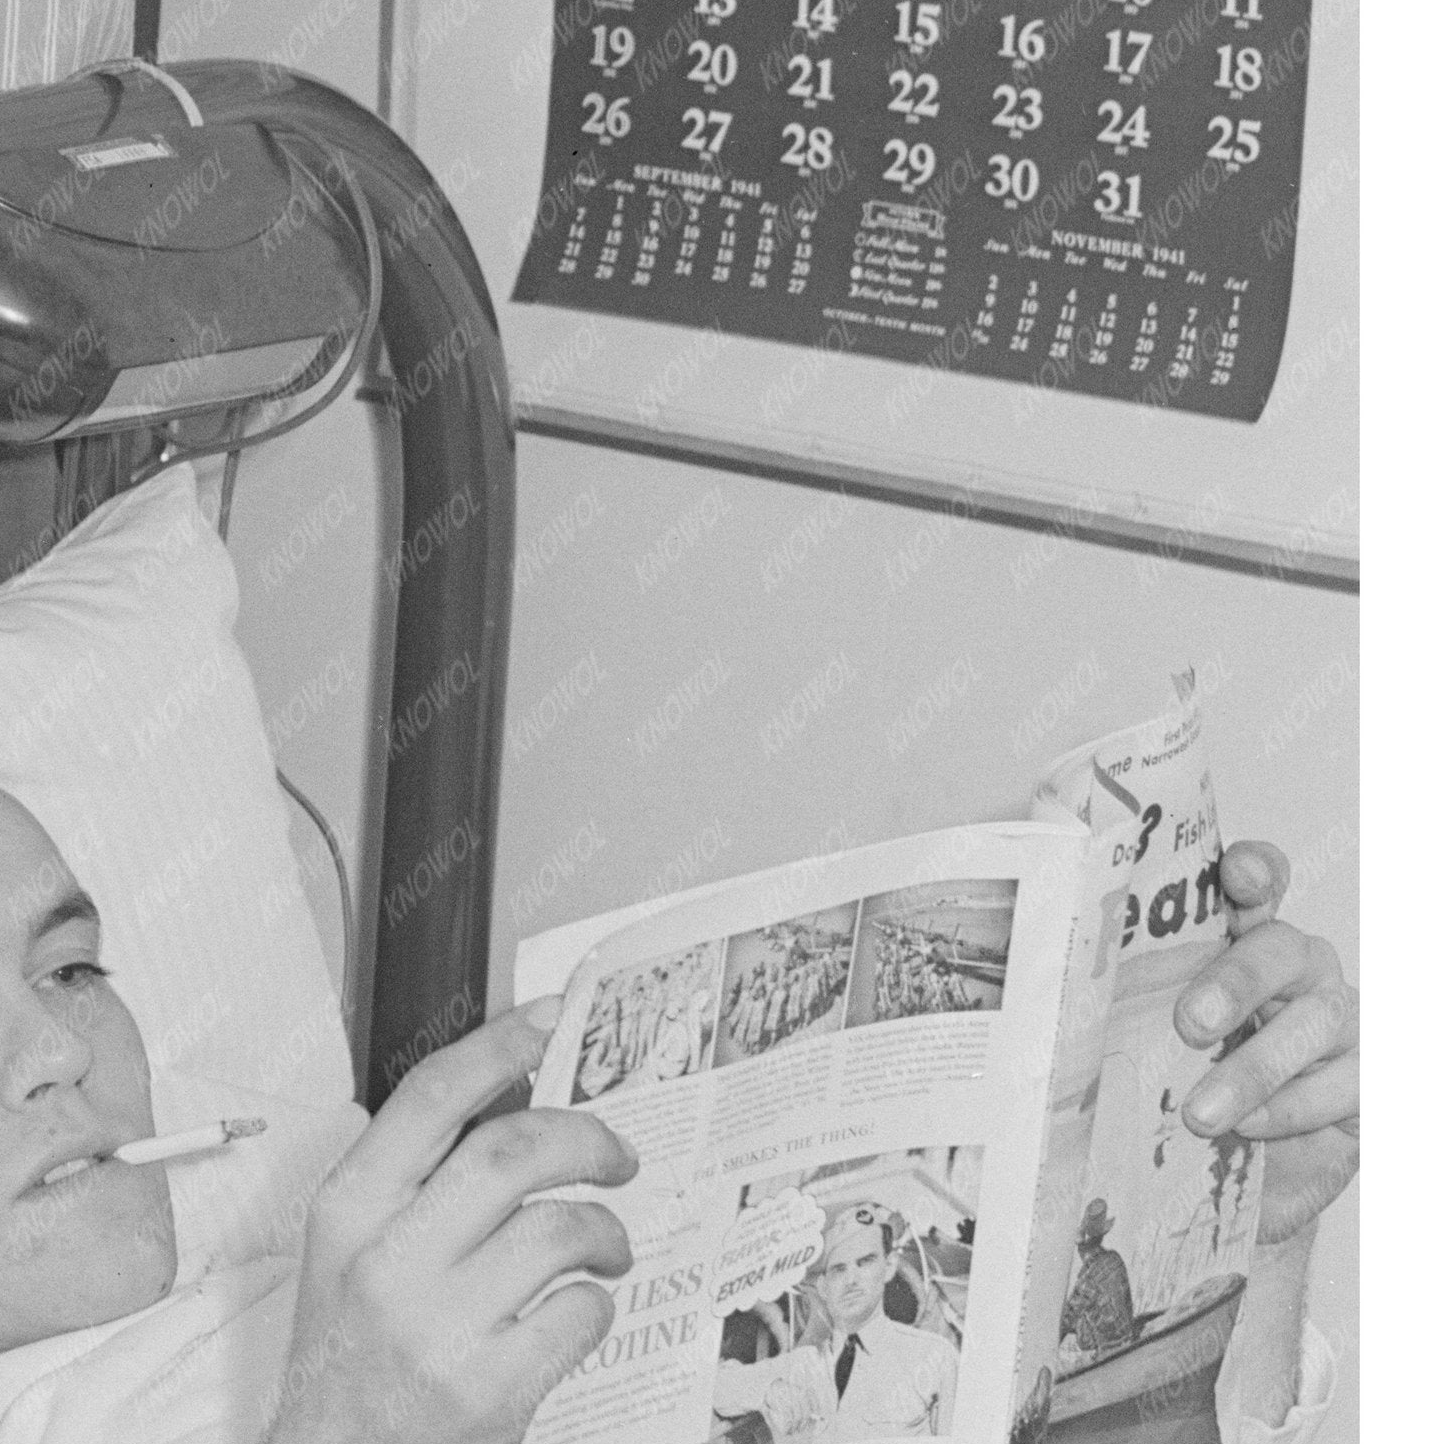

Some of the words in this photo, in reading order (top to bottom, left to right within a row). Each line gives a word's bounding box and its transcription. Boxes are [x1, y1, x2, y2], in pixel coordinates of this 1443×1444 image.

[893, 0, 942, 46] 15
[997, 14, 1046, 63] 16
[1103, 28, 1154, 75] 17
[1213, 43, 1263, 92] 18
[590, 24, 636, 68] 19
[687, 39, 738, 86] 20
[786, 53, 835, 102] 21
[887, 70, 941, 118] 22
[991, 84, 1044, 131] 23
[1096, 99, 1151, 148] 24
[1206, 115, 1262, 163] 25
[581, 92, 632, 138] 26
[681, 107, 733, 153] 27
[780, 123, 834, 170] 28
[882, 138, 936, 185] 29
[985, 154, 1040, 202] 30
[1093, 170, 1142, 218] 31
[633, 164, 723, 192] SEPTEMBER
[731, 179, 762, 197] 1941
[1051, 230, 1146, 260] NOVEMBER
[1152, 246, 1185, 265] 1941
[977, 311, 994, 326] 16
[1017, 318, 1035, 333] 17
[1061, 306, 1077, 322] 11
[1180, 324, 1197, 341] 14
[1067, 287, 1077, 303] 4
[1187, 307, 1198, 323] 7
[722, 1145, 779, 1173] SMOKES
[784, 1134, 813, 1153] THE
[819, 1123, 876, 1145] THING!
[624, 1262, 704, 1315] LESS
[716, 1265, 766, 1303] EXTRA
[769, 1245, 816, 1278] MILD
